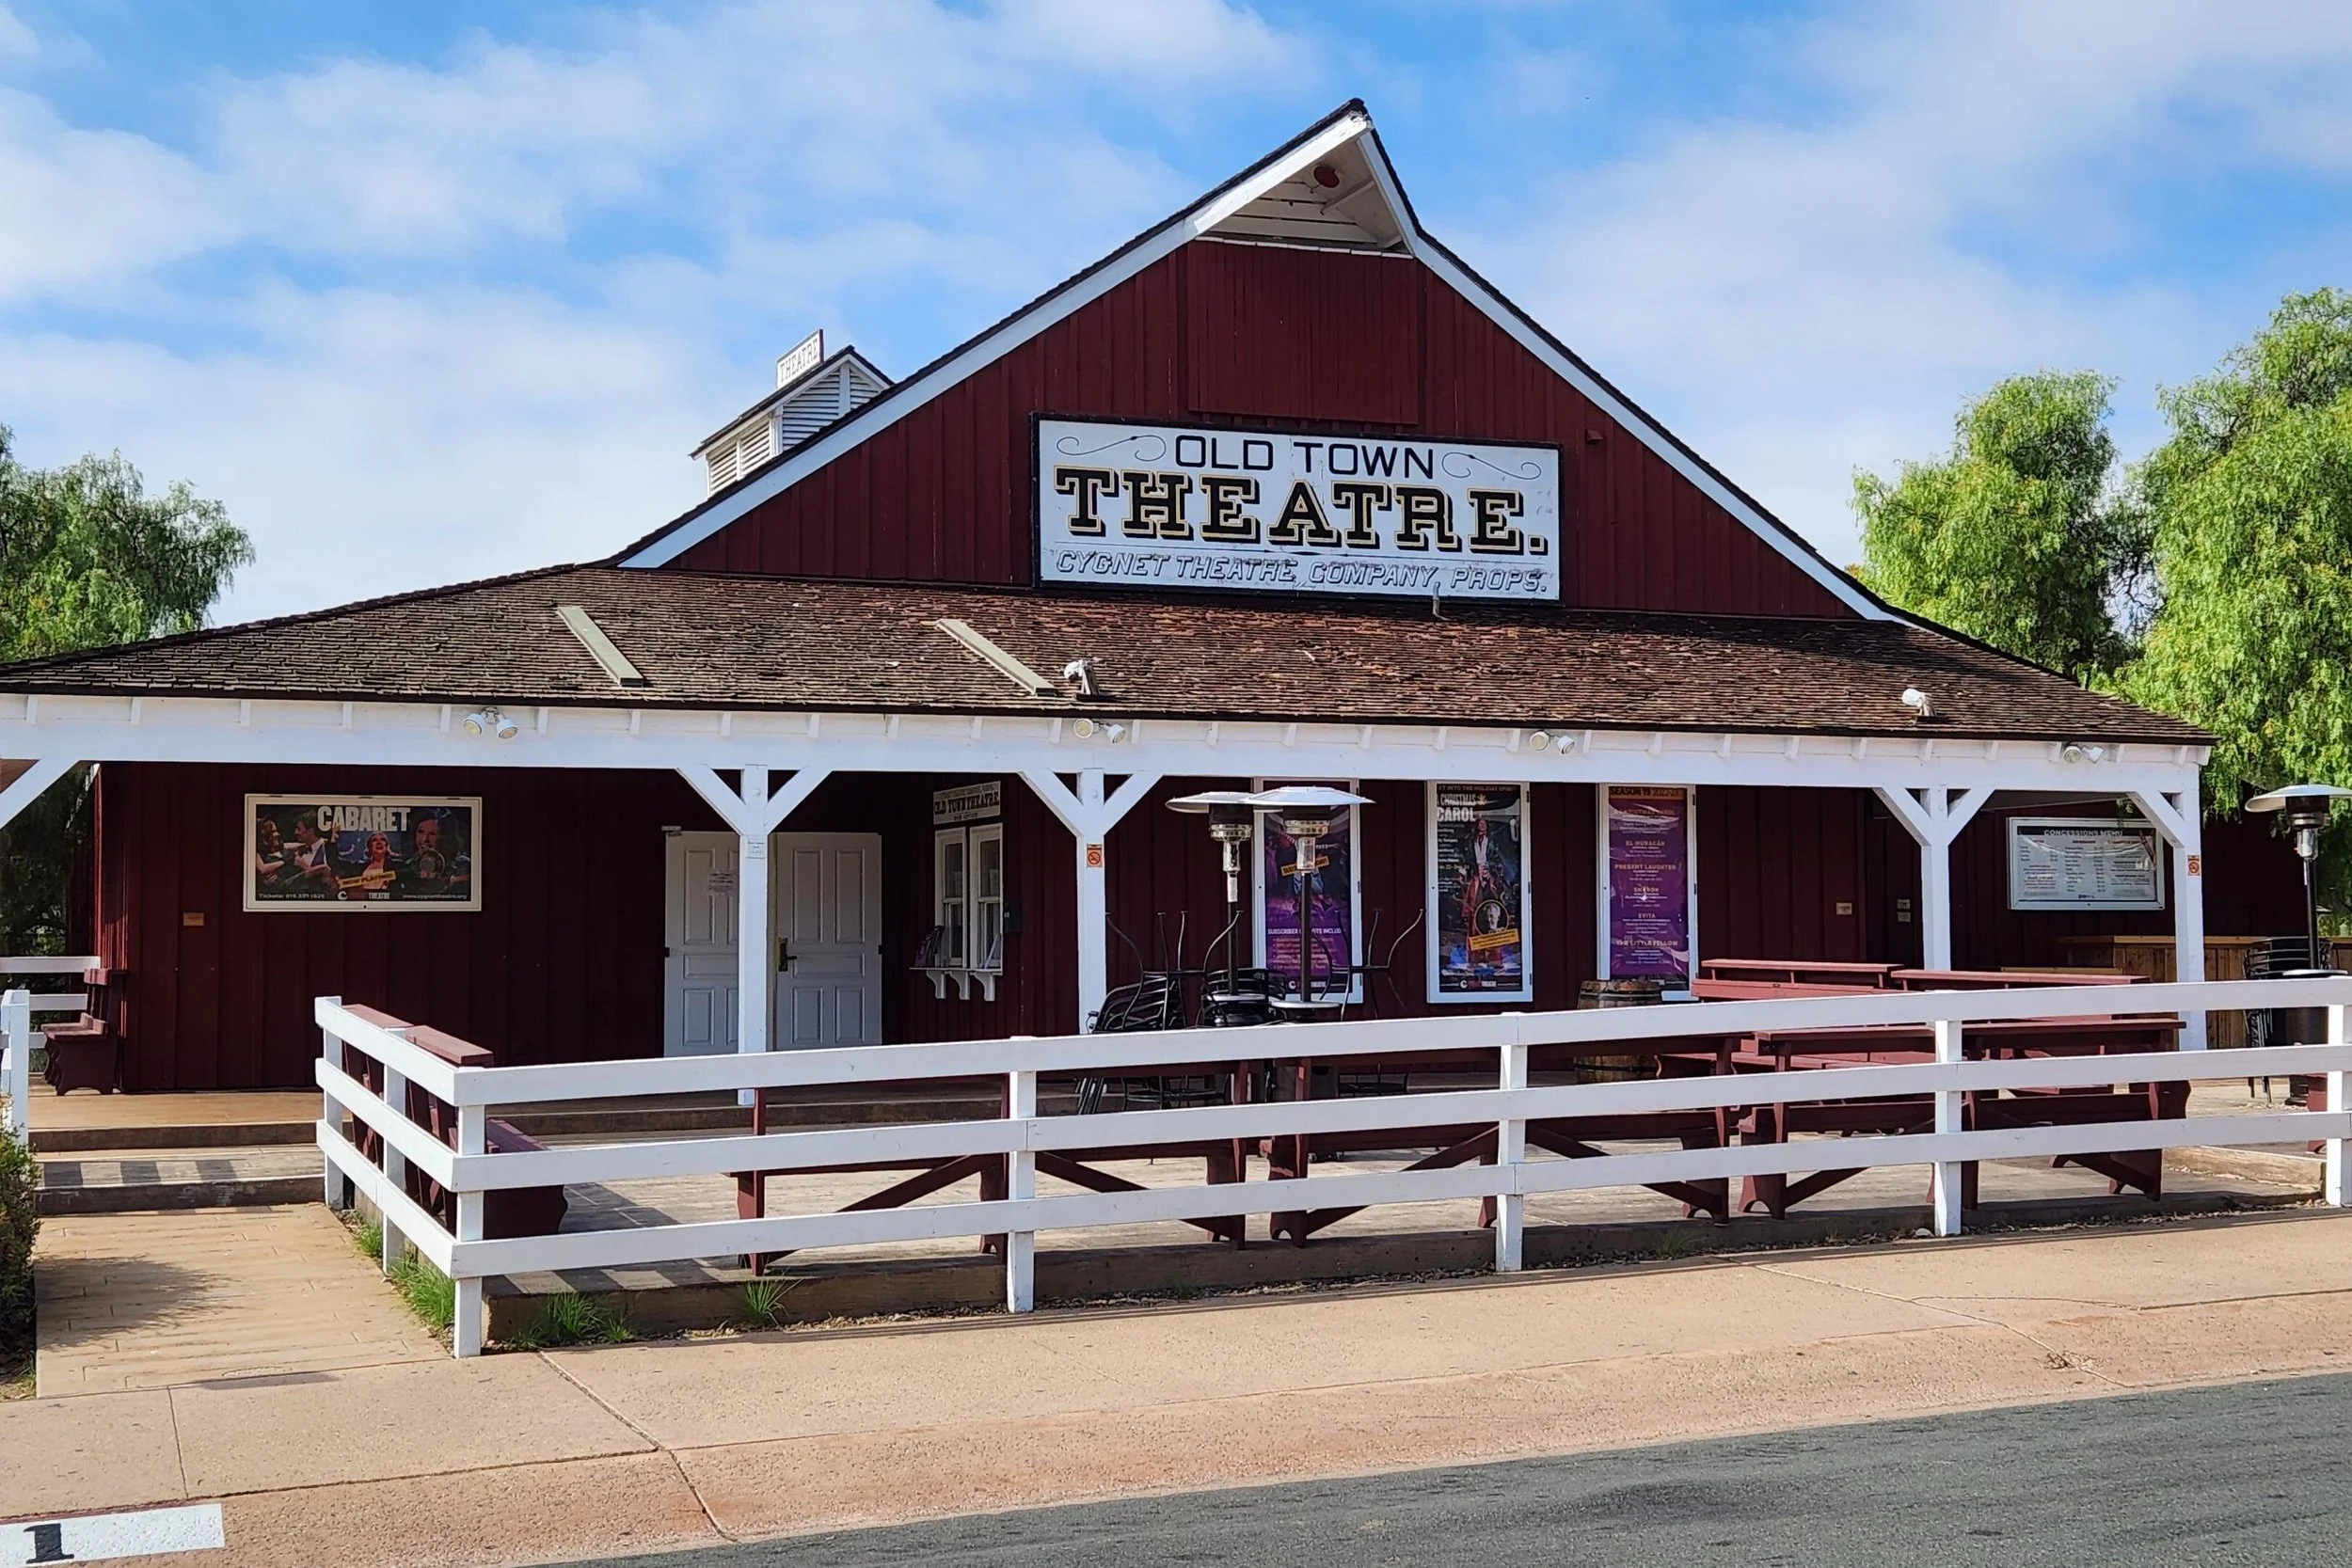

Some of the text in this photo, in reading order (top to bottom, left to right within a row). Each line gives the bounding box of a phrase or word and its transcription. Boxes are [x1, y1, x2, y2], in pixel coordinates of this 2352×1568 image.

[780, 338, 818, 383] THEATRE
[1175, 435, 1435, 479] OLD TOWN
[1054, 465, 1549, 555] THEATRE.
[1057, 549, 1171, 577] CYGNET
[1175, 554, 1298, 582] THEATRE
[1450, 565, 1548, 593] PROPS.
[1610, 786, 1641, 796] SEASON
[318, 805, 411, 832] CABARET
[1437, 807, 1476, 822] CAROL
[368, 892, 390, 900] THEATRE
[24, 1523, 74, 1564] 1
